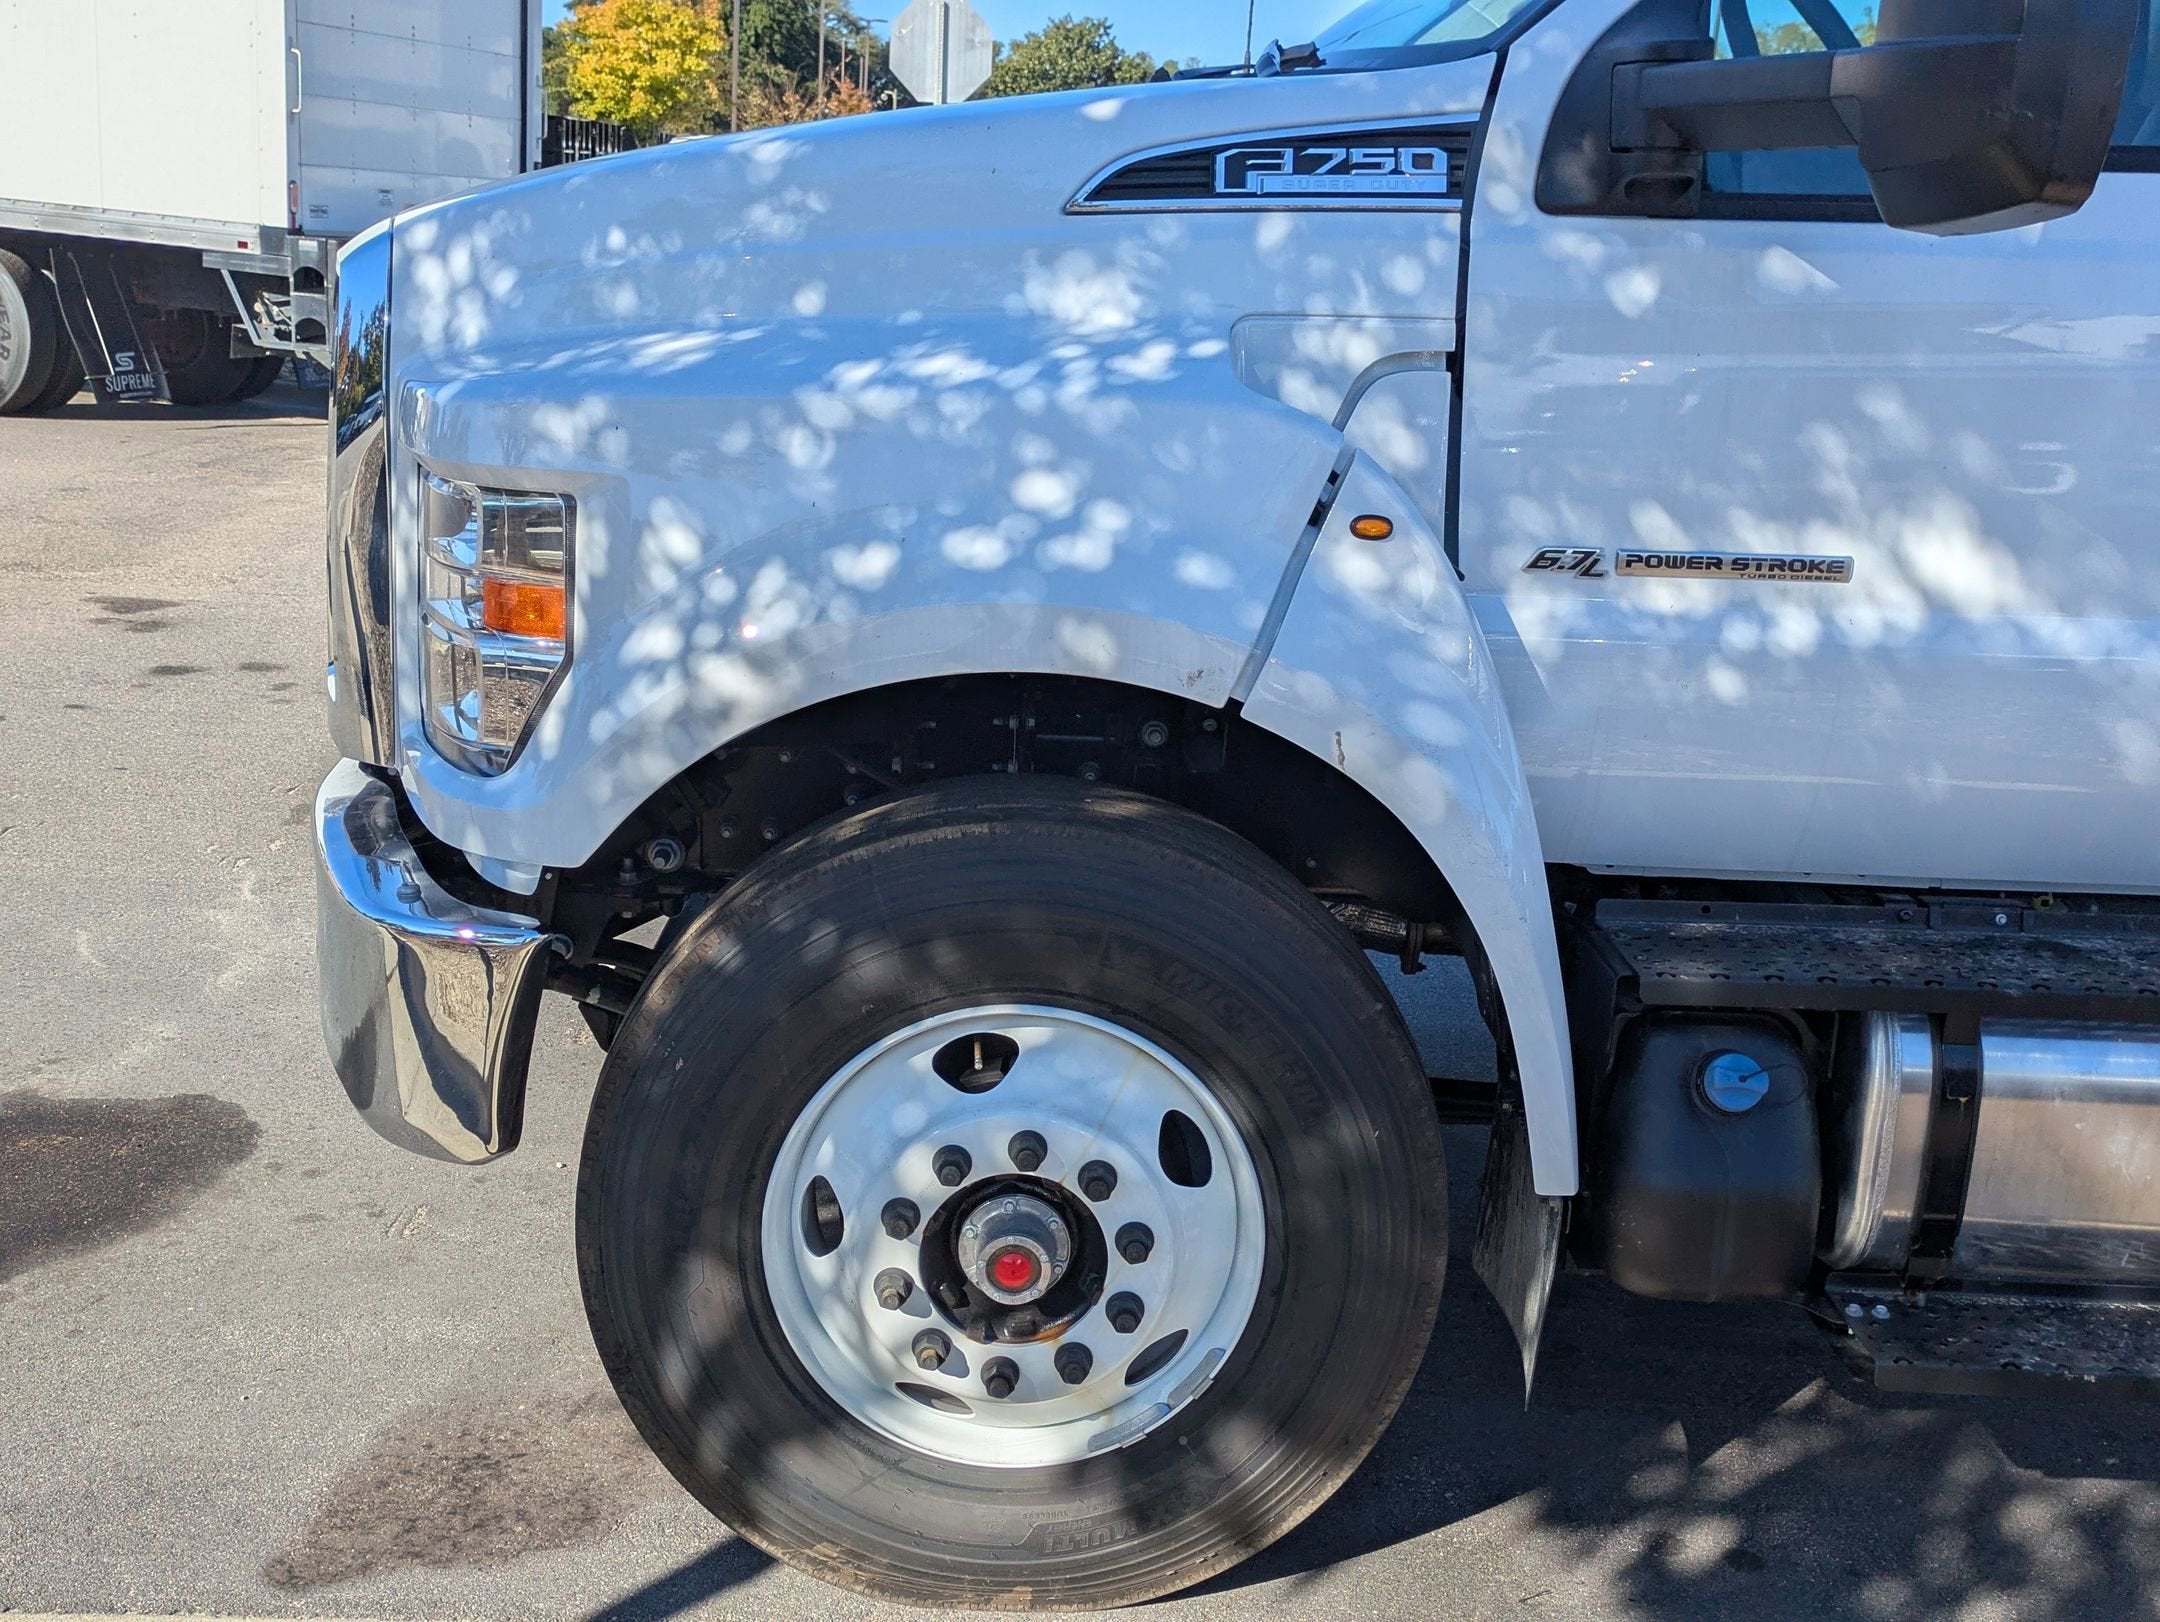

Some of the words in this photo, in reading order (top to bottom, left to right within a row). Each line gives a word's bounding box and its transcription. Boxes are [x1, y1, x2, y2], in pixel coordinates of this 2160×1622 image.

[1281, 179, 1357, 191] SUPER
[1370, 179, 1427, 191] DUTY
[0, 303, 12, 361] EAR
[105, 373, 157, 393] SUPREME
[1523, 548, 1606, 578] 6.7L
[1625, 553, 1723, 571] POWER
[1731, 557, 1845, 574] STROKE
[1790, 574, 1841, 582] DIESEL
